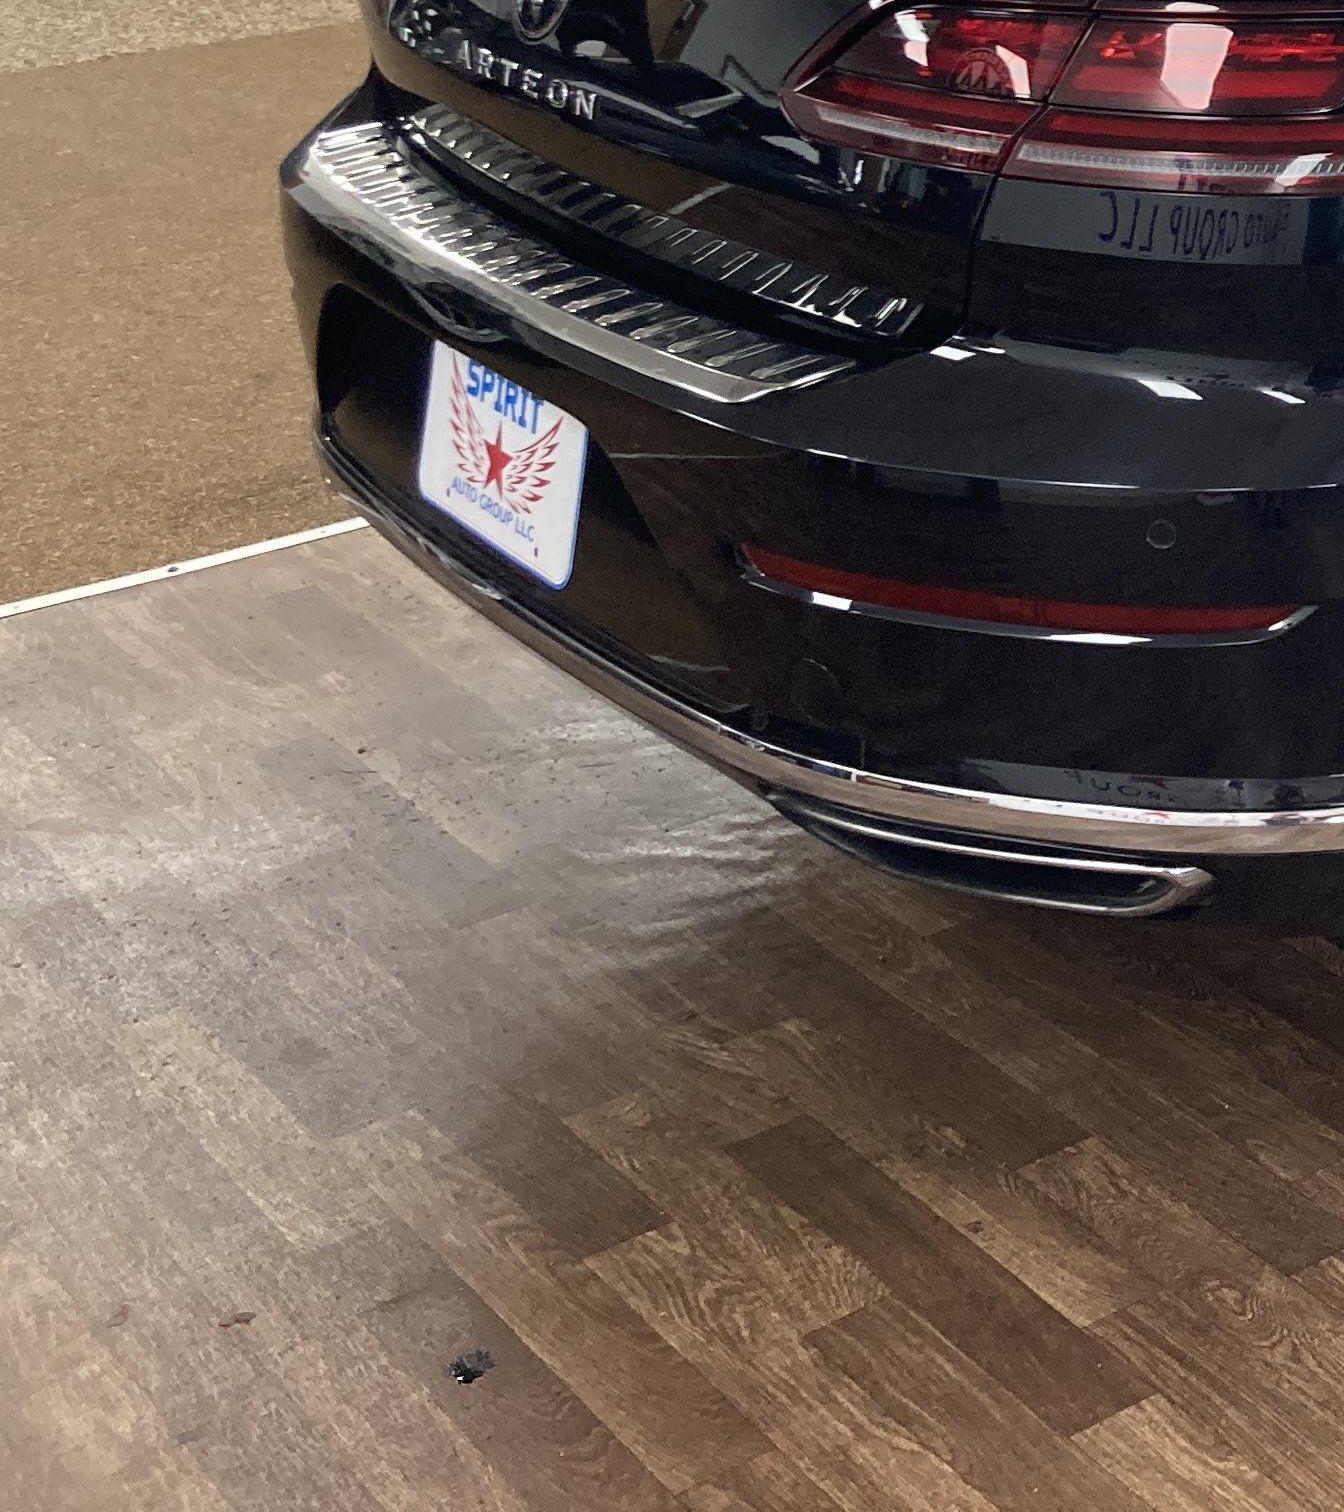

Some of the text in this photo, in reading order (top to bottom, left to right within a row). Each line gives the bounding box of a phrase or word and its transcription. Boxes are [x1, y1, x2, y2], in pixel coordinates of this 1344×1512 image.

[456, 39, 598, 121] ARTEON
[466, 359, 544, 434] SPIRIT
[451, 476, 536, 543] AUTO GROUP LLC
